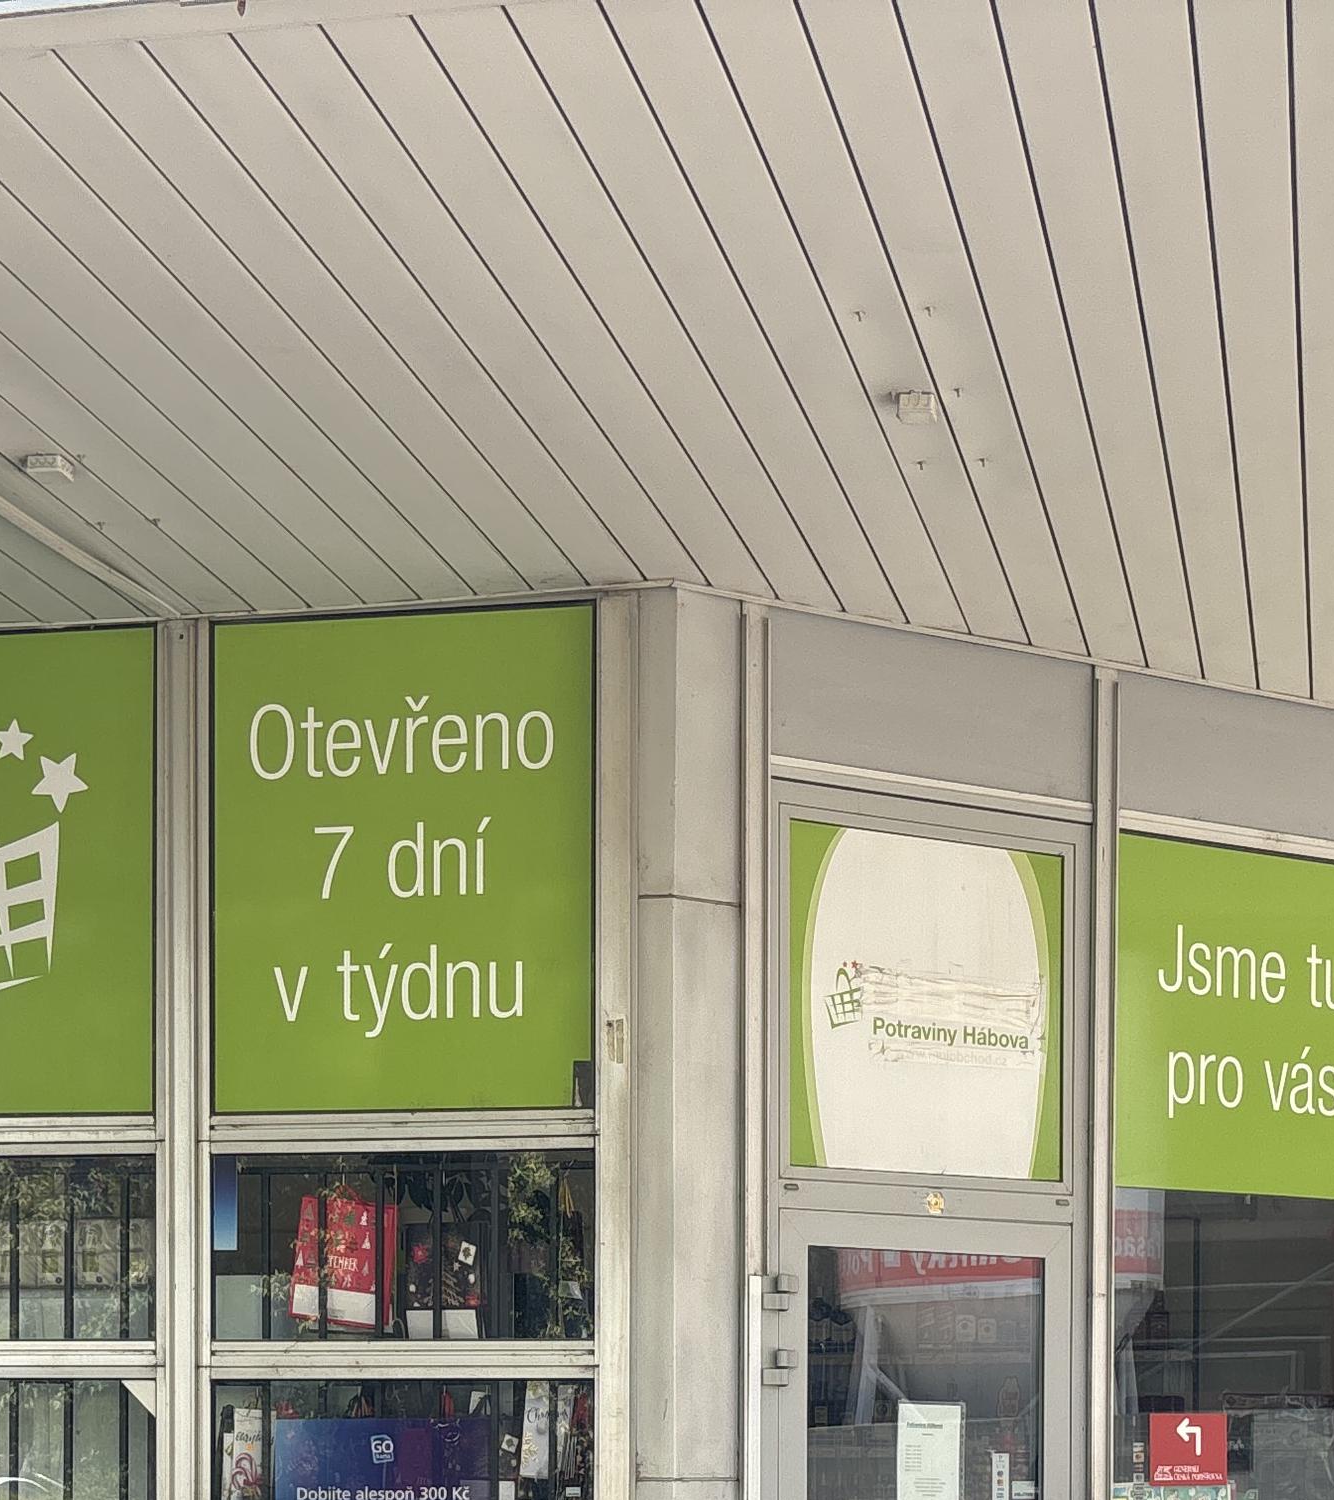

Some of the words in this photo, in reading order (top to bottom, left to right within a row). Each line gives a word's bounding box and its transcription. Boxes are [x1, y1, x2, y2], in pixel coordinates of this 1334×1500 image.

[250, 696, 554, 780] Otevřeno
[314, 826, 355, 899] 7
[387, 816, 492, 898] dní
[274, 966, 308, 1022] v
[336, 943, 524, 1038] týdnu
[1158, 924, 1287, 1004] Jsme
[872, 1016, 957, 1046] Potraviny
[963, 1024, 1029, 1050] Hábova
[1168, 1049, 1244, 1119] pro
[372, 1440, 394, 1453] GO
[419, 1487, 448, 1500] 300
[452, 1486, 470, 1500] Kč
